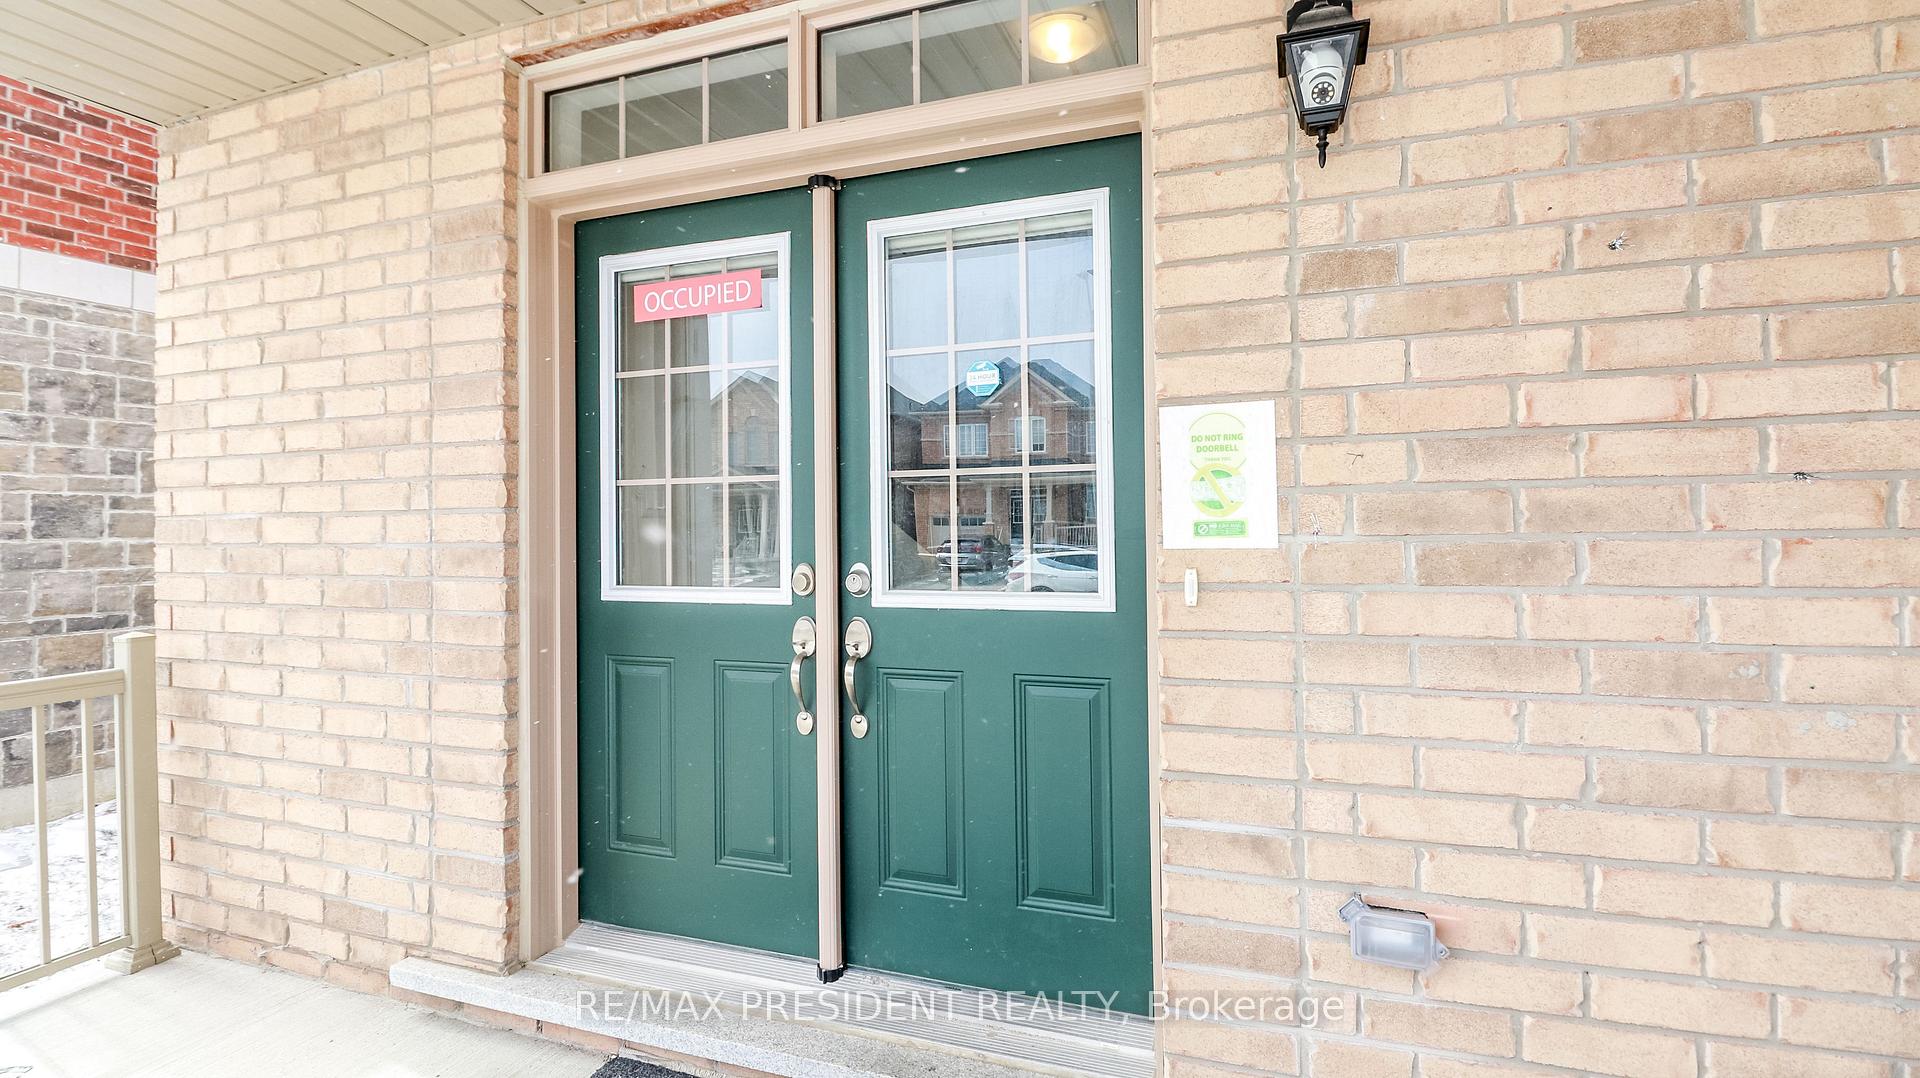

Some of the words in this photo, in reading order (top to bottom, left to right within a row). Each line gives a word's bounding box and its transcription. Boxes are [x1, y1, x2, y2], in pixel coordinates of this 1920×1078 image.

[644, 280, 752, 313] OCCUPIED
[1191, 435, 1204, 443] DO
[1204, 434, 1221, 442] NOT
[1223, 432, 1244, 441] RING
[1196, 444, 1239, 453] DOORBELL
